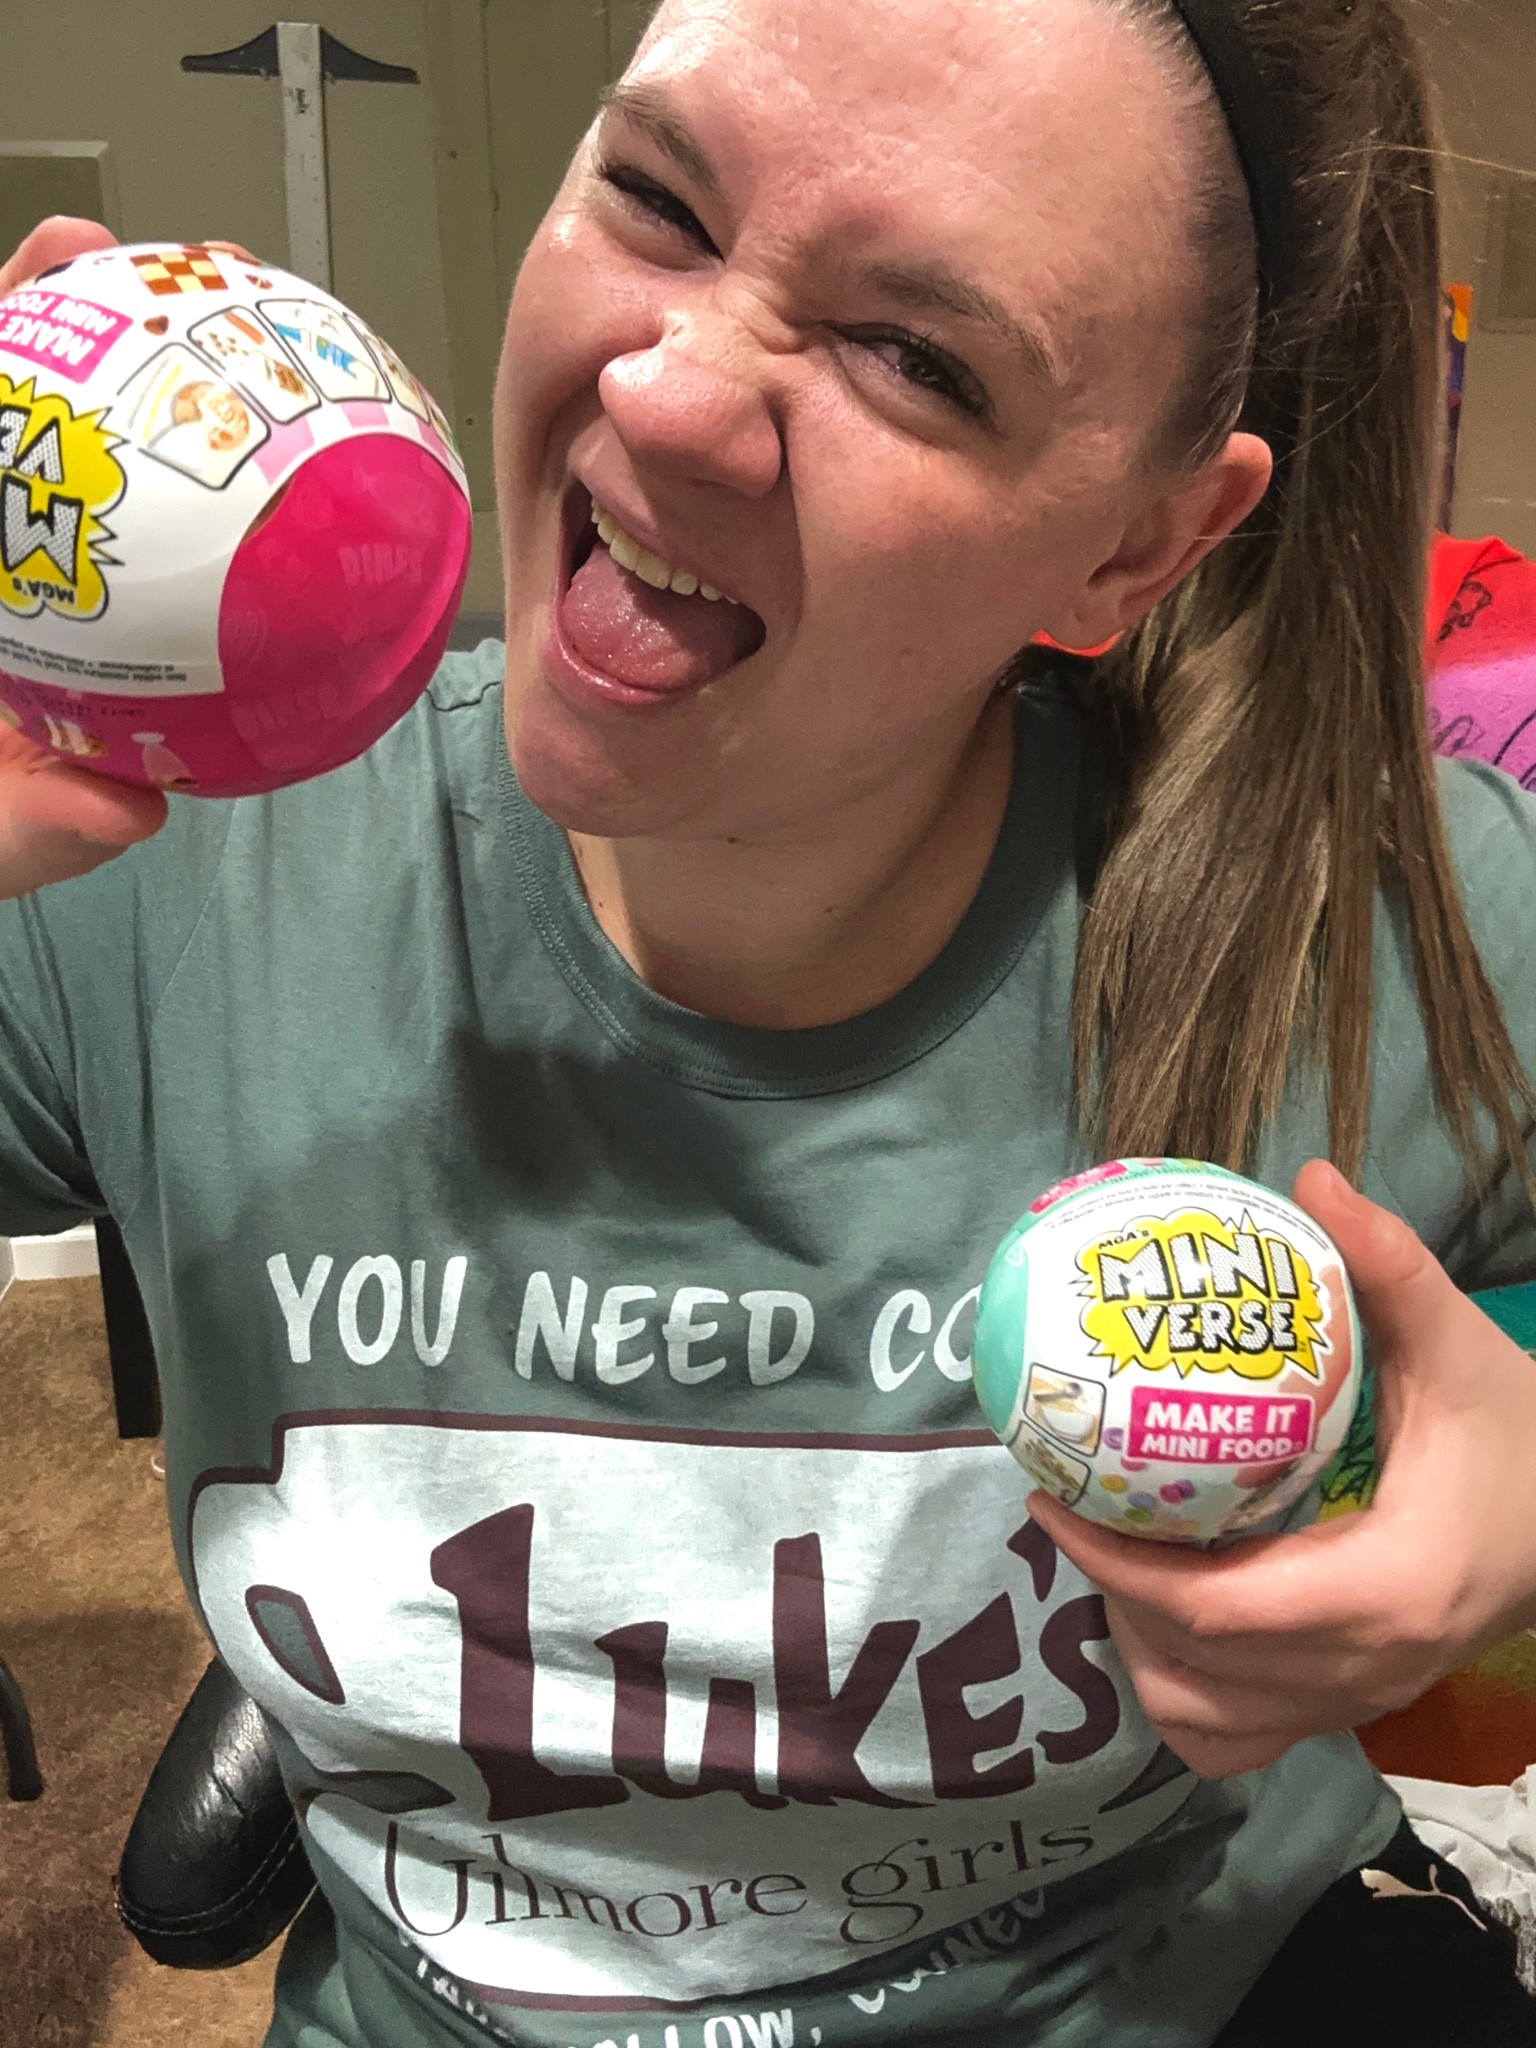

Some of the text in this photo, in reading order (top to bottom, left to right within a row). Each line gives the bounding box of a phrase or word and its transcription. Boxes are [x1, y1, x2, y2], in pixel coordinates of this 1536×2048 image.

[50, 298, 117, 336] MINI
[1098, 1232, 1300, 1302] MINI
[266, 1252, 468, 1367] YOU
[514, 1270, 815, 1386] NEED
[1122, 1300, 1297, 1354] VERSE
[1144, 1401, 1297, 1434] MAKE IT
[1140, 1433, 1294, 1460] MINI FOOD
[839, 1818, 1097, 1945] girls
